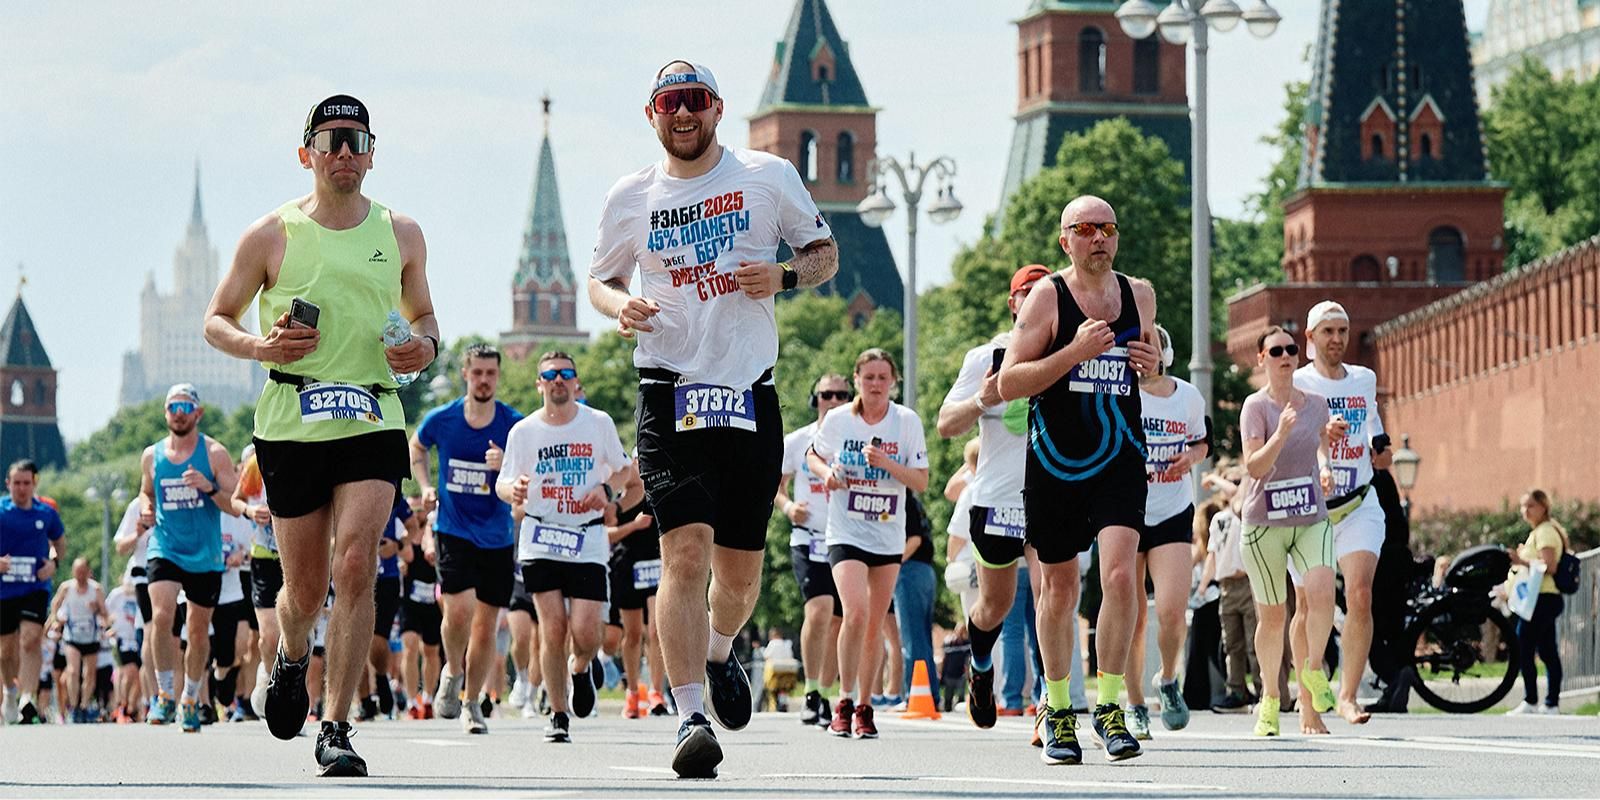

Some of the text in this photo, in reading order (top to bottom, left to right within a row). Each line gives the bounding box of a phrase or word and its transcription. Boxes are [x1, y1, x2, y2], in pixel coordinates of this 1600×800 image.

[323, 104, 359, 116] LET'S MOVE
[647, 210, 750, 253] 45% ПЛАНЕТЫ
[694, 234, 735, 264] БЕГУТ
[697, 278, 708, 302] С
[1078, 359, 1126, 382] 30037
[309, 390, 373, 412] 32705
[686, 388, 746, 414] 37372
[331, 409, 357, 420] 10KM
[685, 414, 731, 428] B 10KM
[562, 472, 587, 486] БЕГУТ
[541, 486, 573, 500] ВМЕСТЕ
[1271, 487, 1310, 509] 60547
